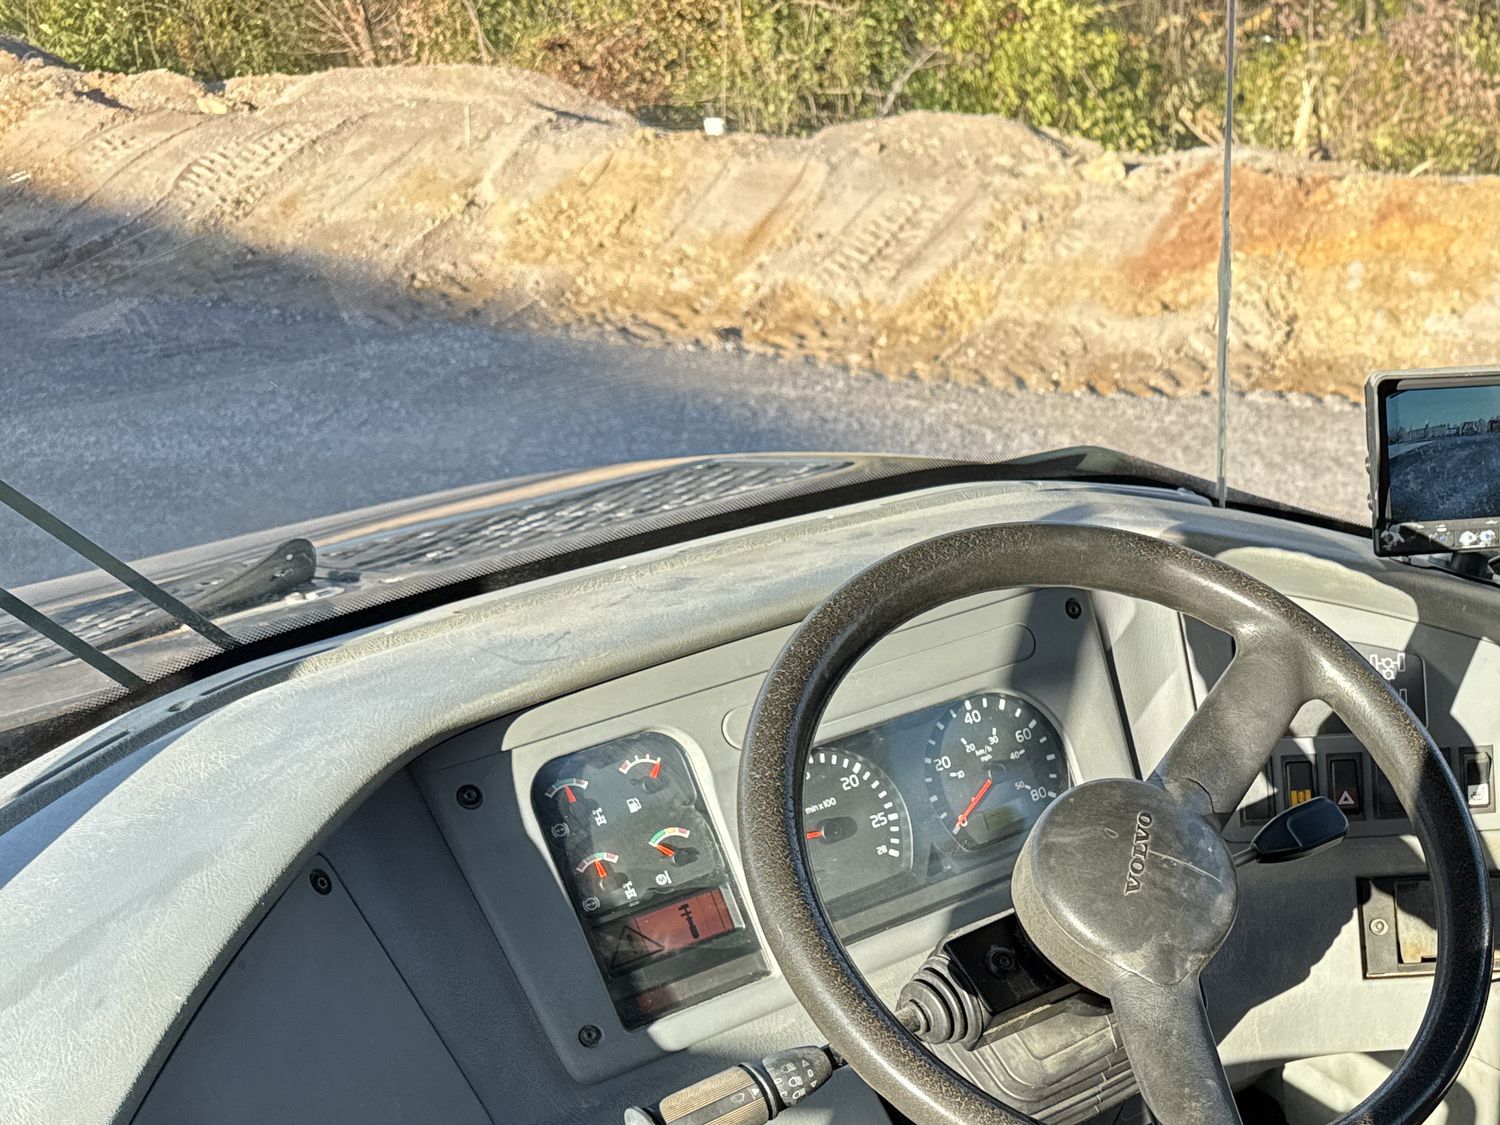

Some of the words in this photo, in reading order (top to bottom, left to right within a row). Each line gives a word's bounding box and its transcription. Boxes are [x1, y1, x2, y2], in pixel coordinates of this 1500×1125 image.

[964, 710, 981, 725] 40
[988, 736, 999, 745] 30
[1015, 728, 1032, 743] 60
[965, 743, 976, 753] 20
[975, 745, 993, 756] km/h
[934, 755, 951, 771] 20
[840, 775, 860, 791] 20
[1030, 786, 1047, 802] 80
[869, 812, 888, 828] 25
[876, 845, 887, 856] 28
[1124, 811, 1153, 895] VOLVO
